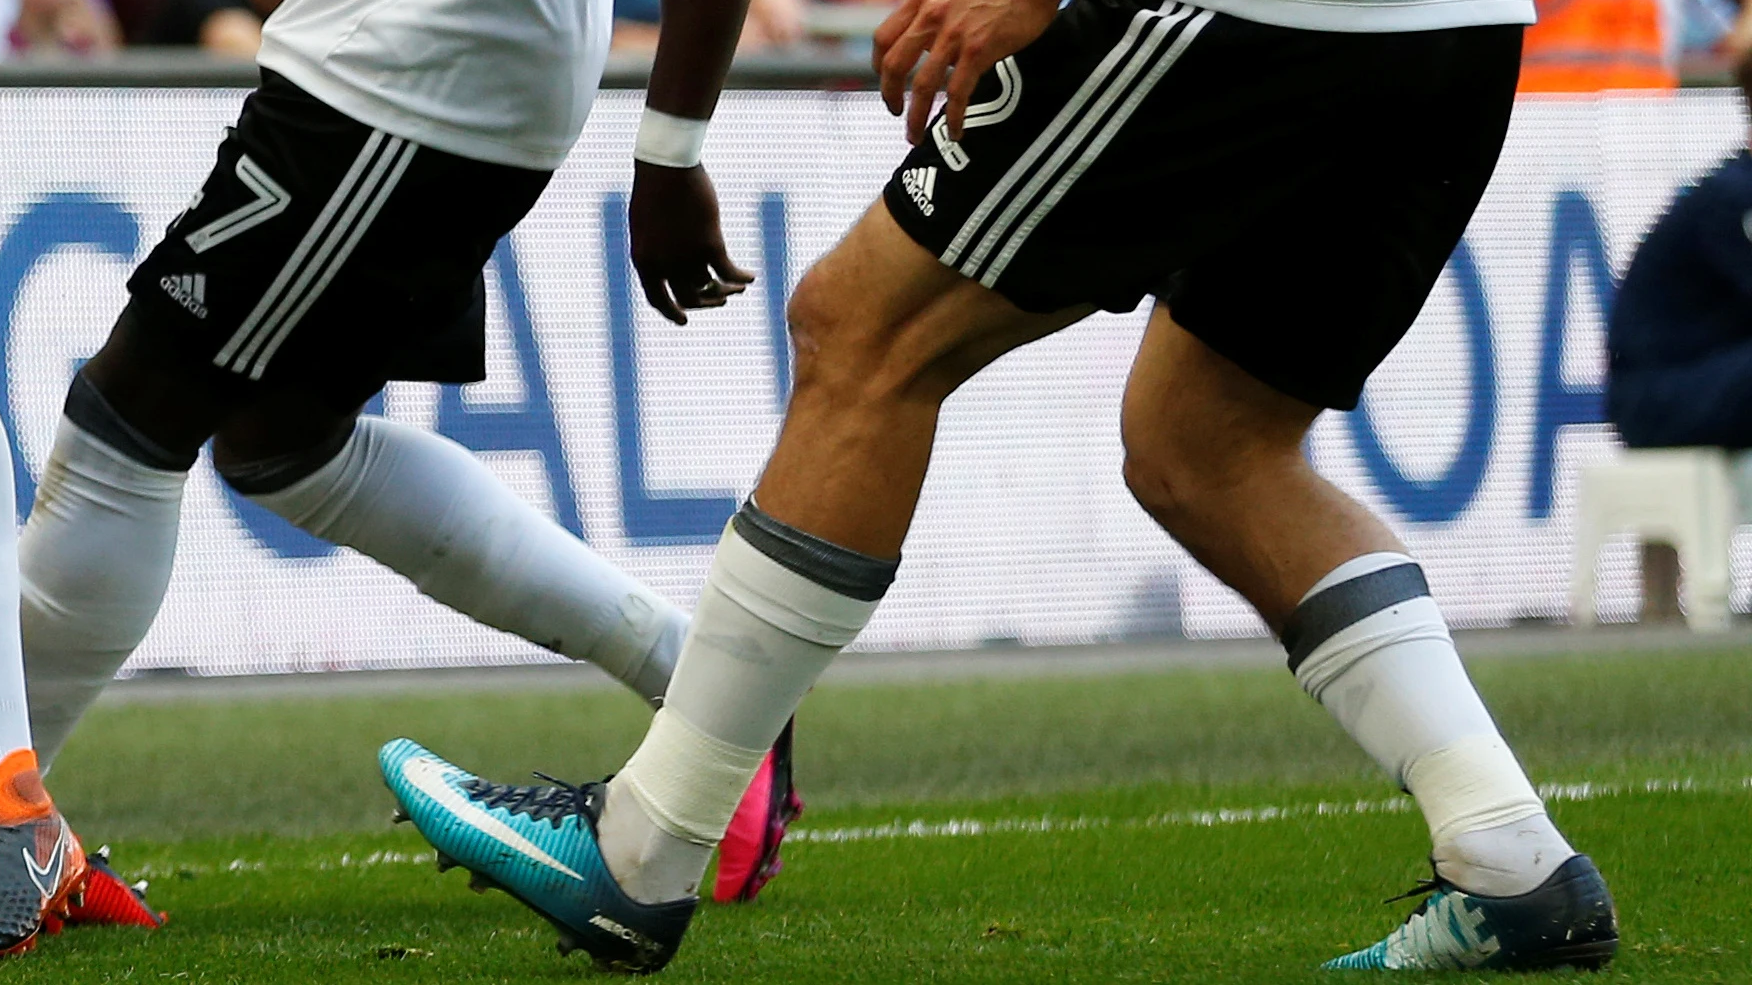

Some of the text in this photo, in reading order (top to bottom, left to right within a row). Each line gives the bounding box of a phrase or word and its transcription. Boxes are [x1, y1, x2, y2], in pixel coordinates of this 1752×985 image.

[184, 153, 292, 255] 7
[901, 168, 935, 217] adidas
[159, 275, 209, 320] adidas
